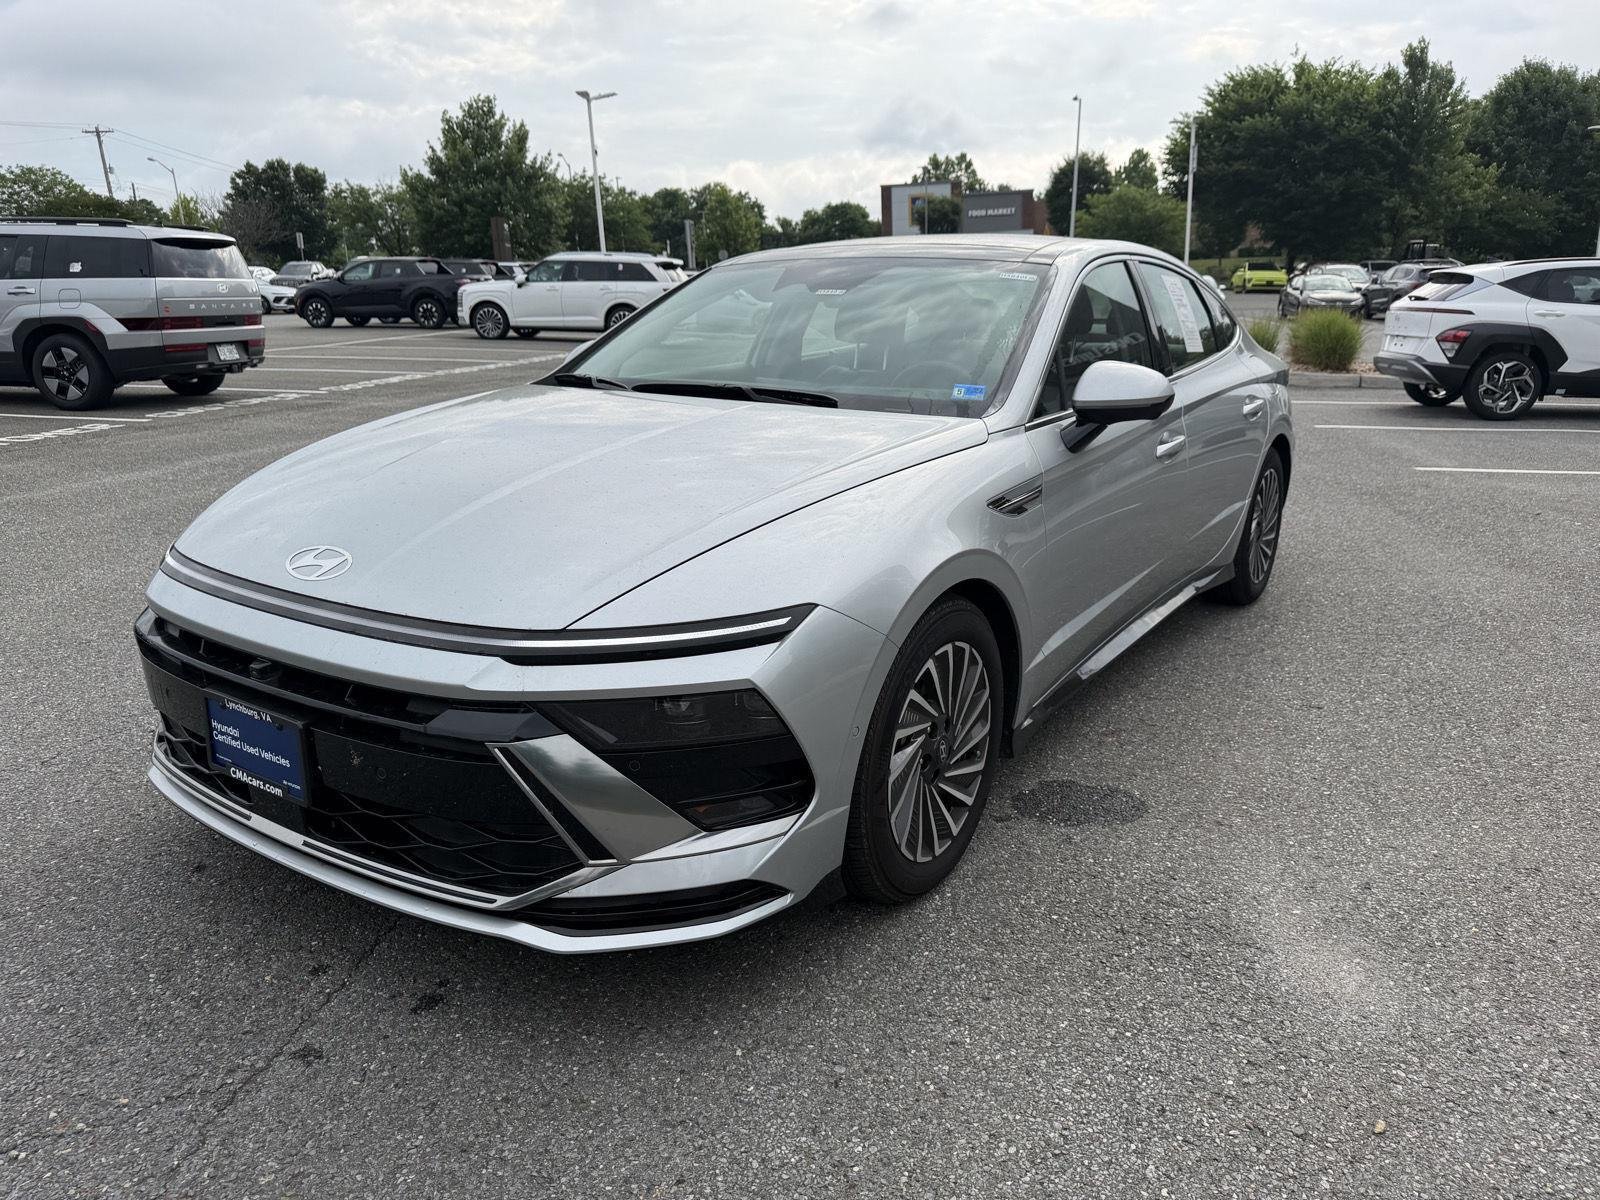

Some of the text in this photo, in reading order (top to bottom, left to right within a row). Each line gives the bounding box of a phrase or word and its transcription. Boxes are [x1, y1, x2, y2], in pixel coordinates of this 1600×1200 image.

[968, 207, 1016, 217] FOOD MARKET
[225, 699, 273, 723] Lynchburg, VA
[211, 718, 240, 737] Hyundai
[212, 730, 291, 768] Certified Used Vehicles
[230, 767, 283, 797] CMAcars.com
